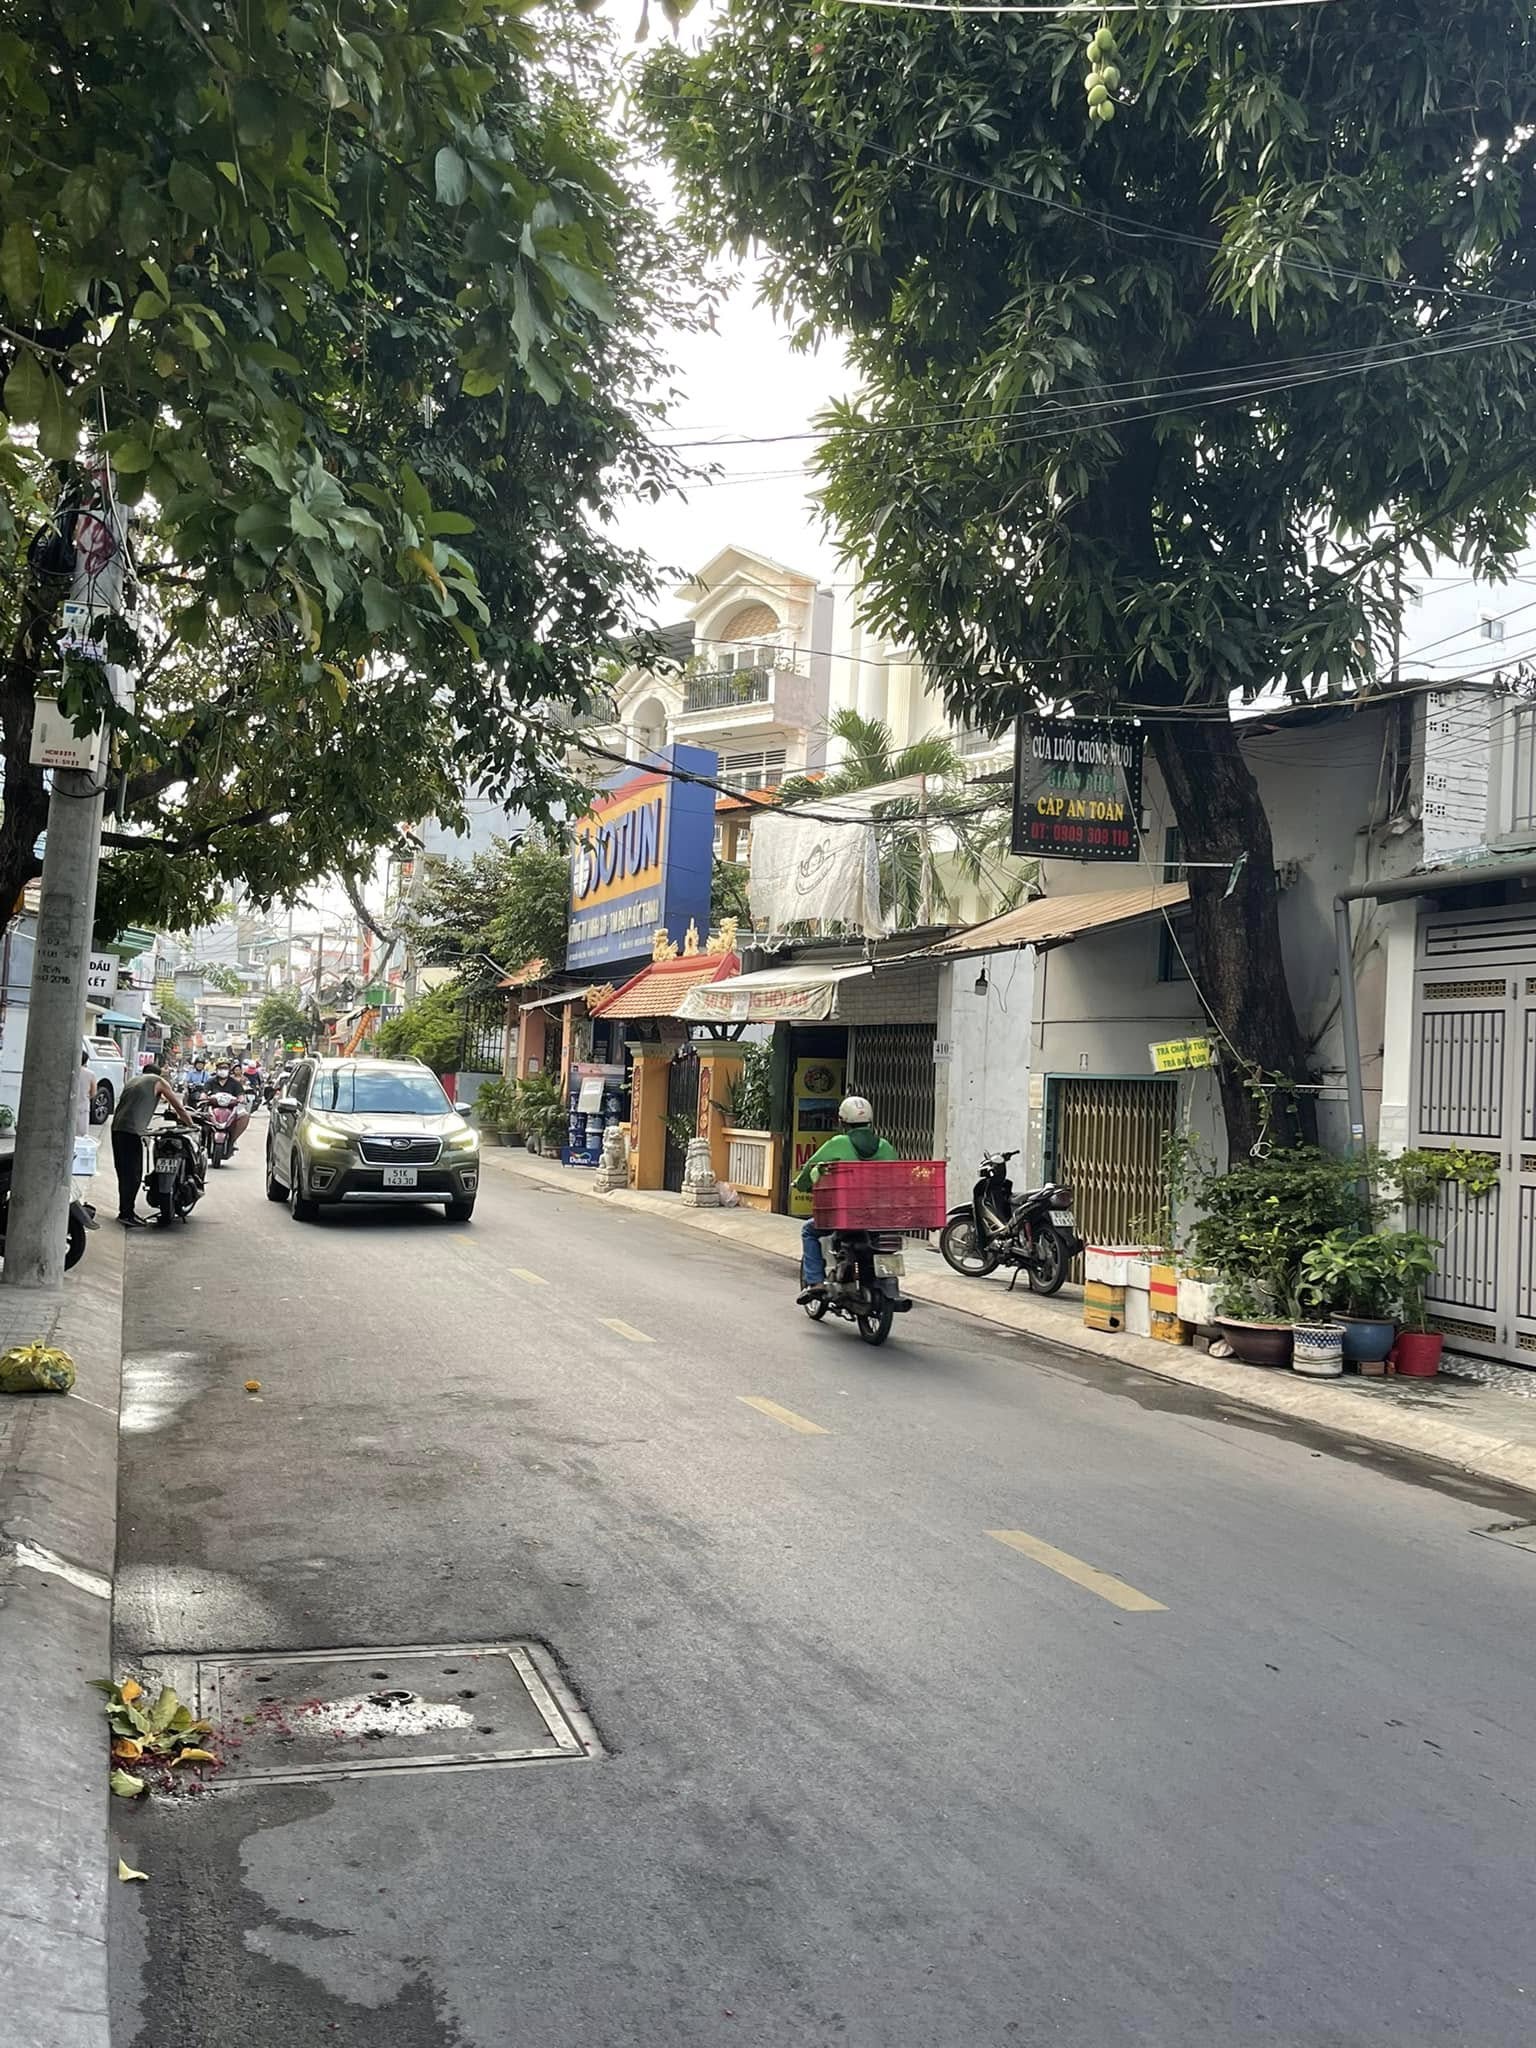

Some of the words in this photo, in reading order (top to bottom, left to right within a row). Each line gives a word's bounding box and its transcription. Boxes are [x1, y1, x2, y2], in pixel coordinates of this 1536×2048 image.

[1037, 792, 1063, 817] CÁP
[1067, 800, 1085, 818] AN
[1089, 798, 1124, 821] TOÀN
[591, 798, 662, 892] JOTUN
